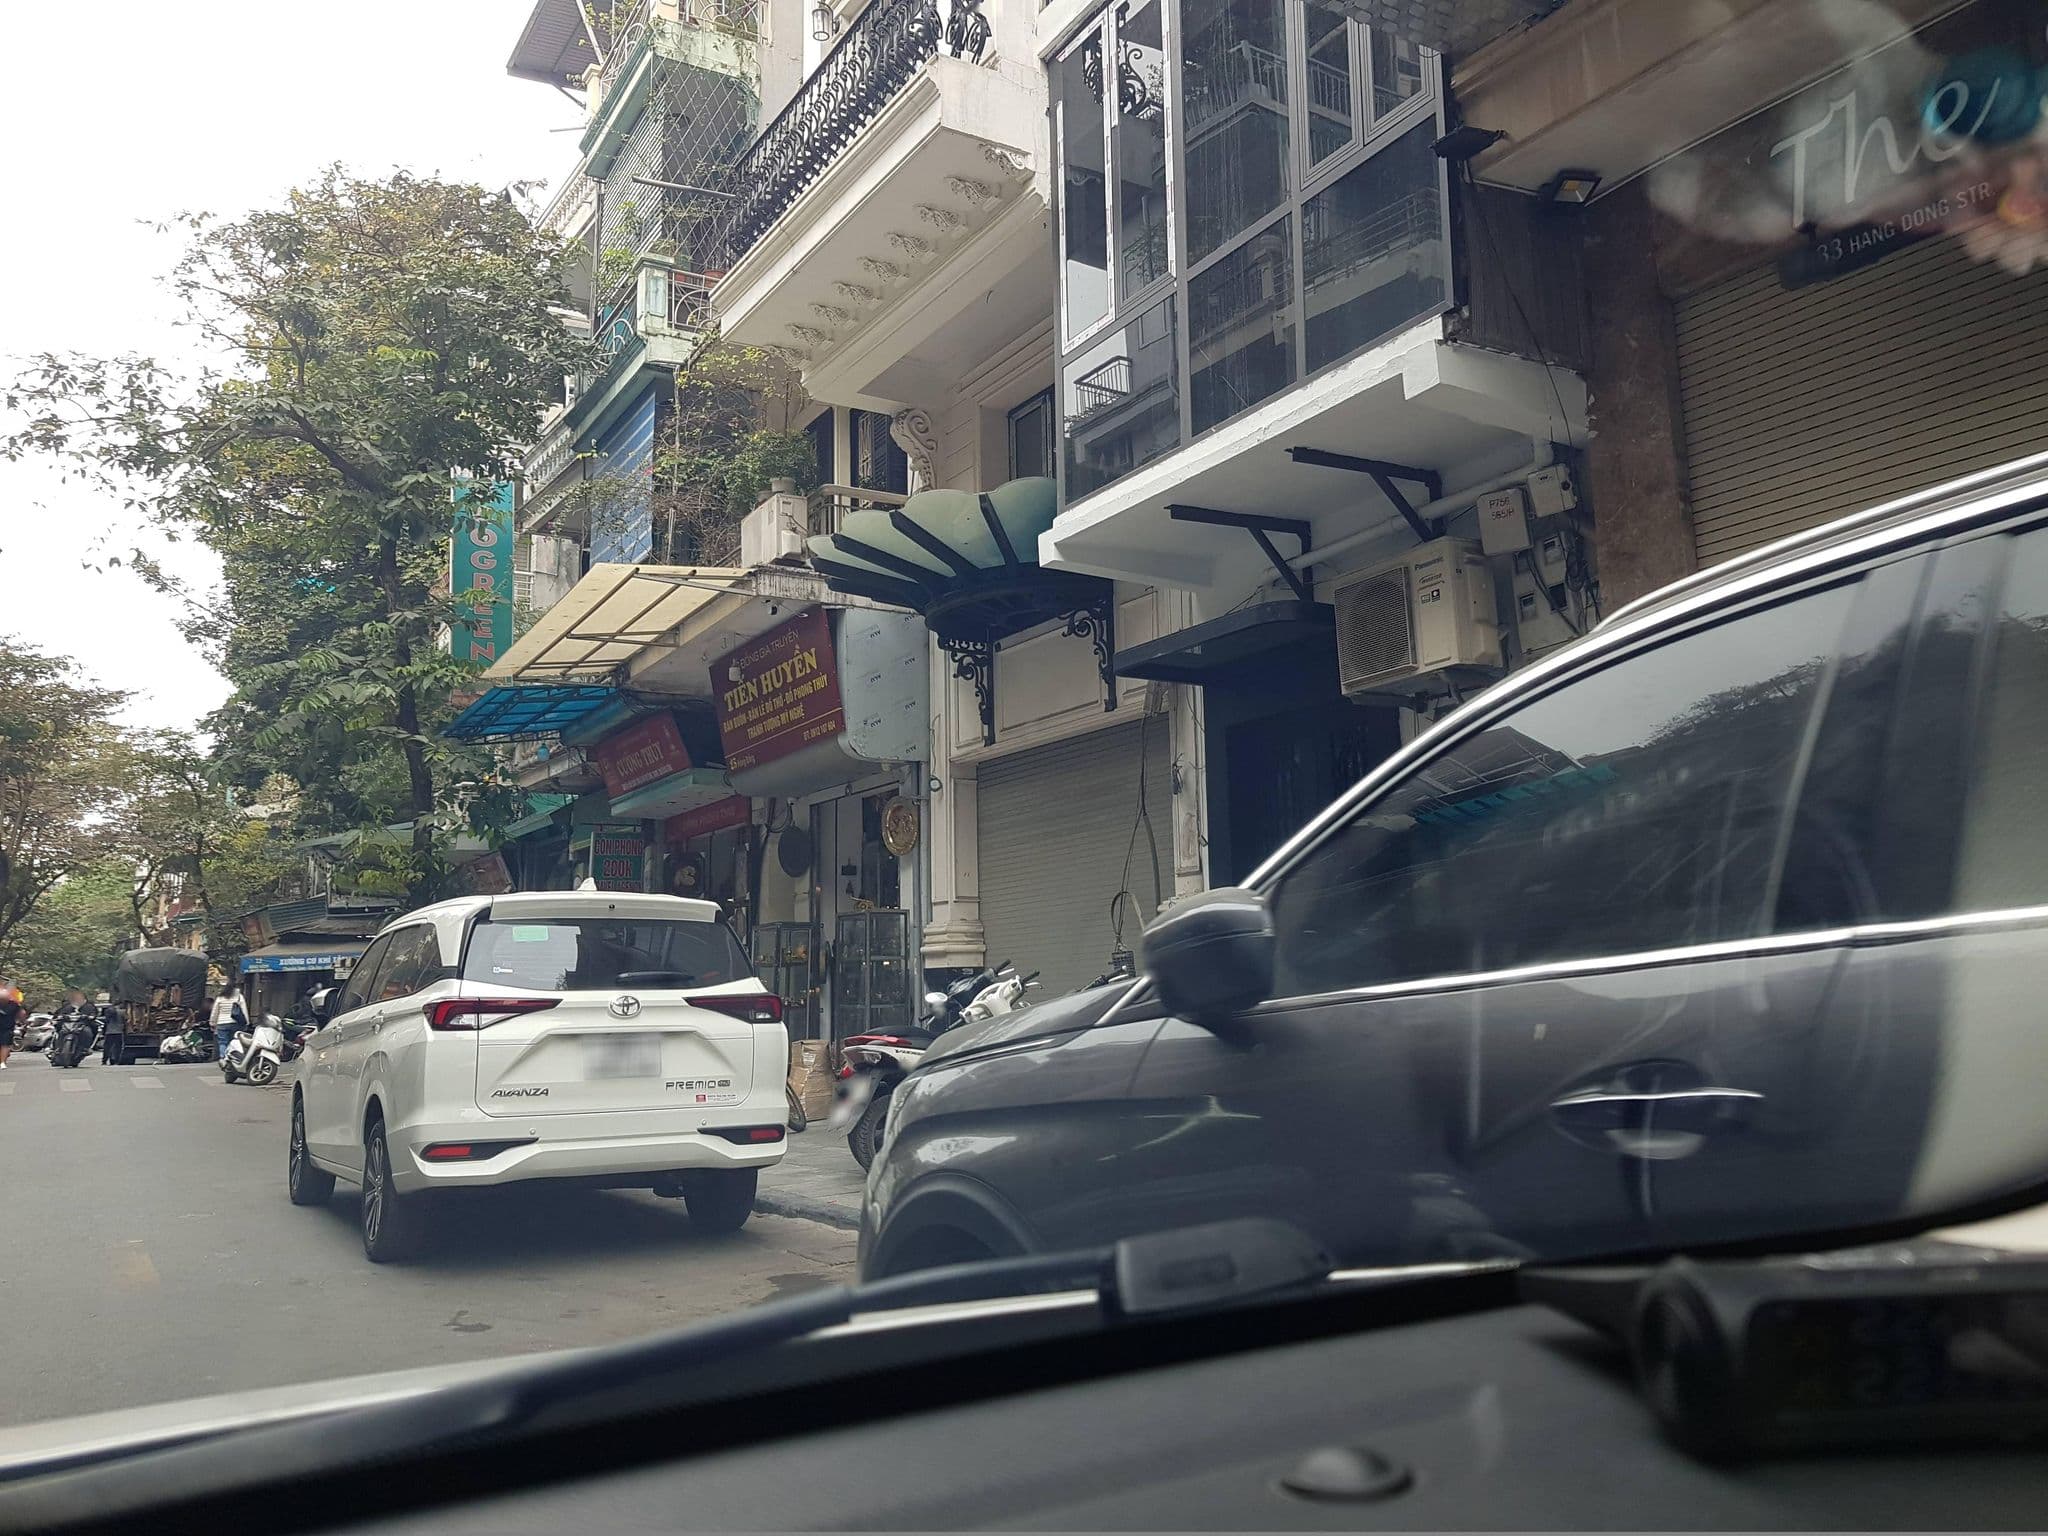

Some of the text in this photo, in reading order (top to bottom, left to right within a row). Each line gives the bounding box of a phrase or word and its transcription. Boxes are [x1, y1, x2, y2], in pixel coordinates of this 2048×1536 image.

[1770, 78, 2000, 229] The
[1817, 239, 1842, 262] 33
[1850, 221, 1895, 254] HANG
[1901, 199, 1951, 233] DONG
[760, 644, 818, 695] HUYỀN
[490, 1087, 549, 1098] AVANZA
[665, 1080, 717, 1091] PREMIO
